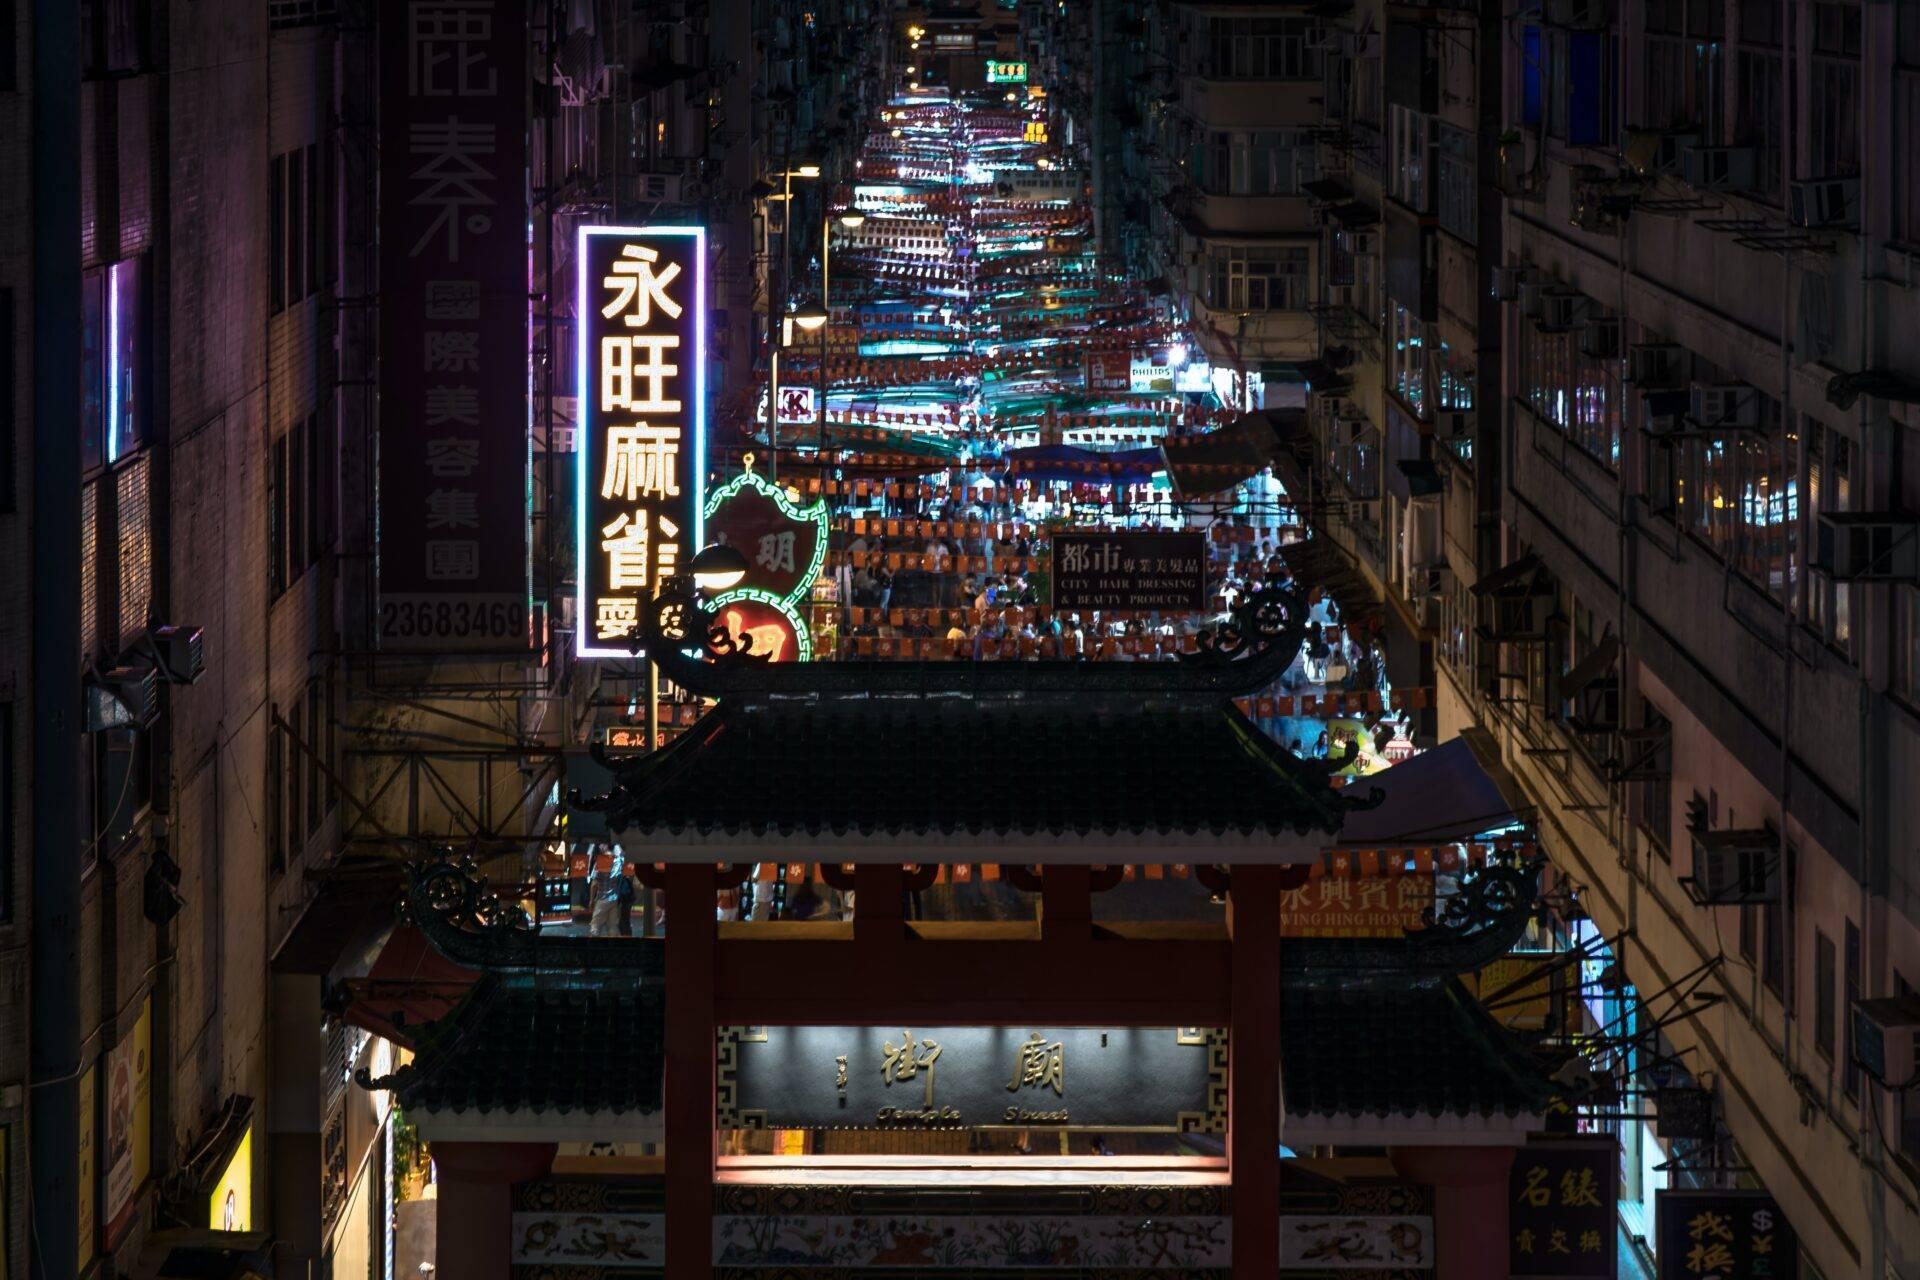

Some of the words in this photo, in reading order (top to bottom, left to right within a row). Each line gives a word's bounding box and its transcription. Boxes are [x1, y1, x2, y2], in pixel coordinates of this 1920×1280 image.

[1132, 367, 1171, 376] PHILIPS
[424, 279, 480, 581] 國際美容集團
[1060, 579, 1090, 590] CITY
[1099, 579, 1131, 590] HAIR
[1137, 579, 1197, 590] DRESSING
[1077, 594, 1122, 606] BEAUTY
[1129, 594, 1191, 606] PRODUCTS
[382, 601, 525, 639] 23683469
[1325, 912, 1365, 927] HING
[1368, 912, 1426, 928] HOSTE
[876, 1105, 962, 1123] Temple
[1003, 1106, 1069, 1121] Street
